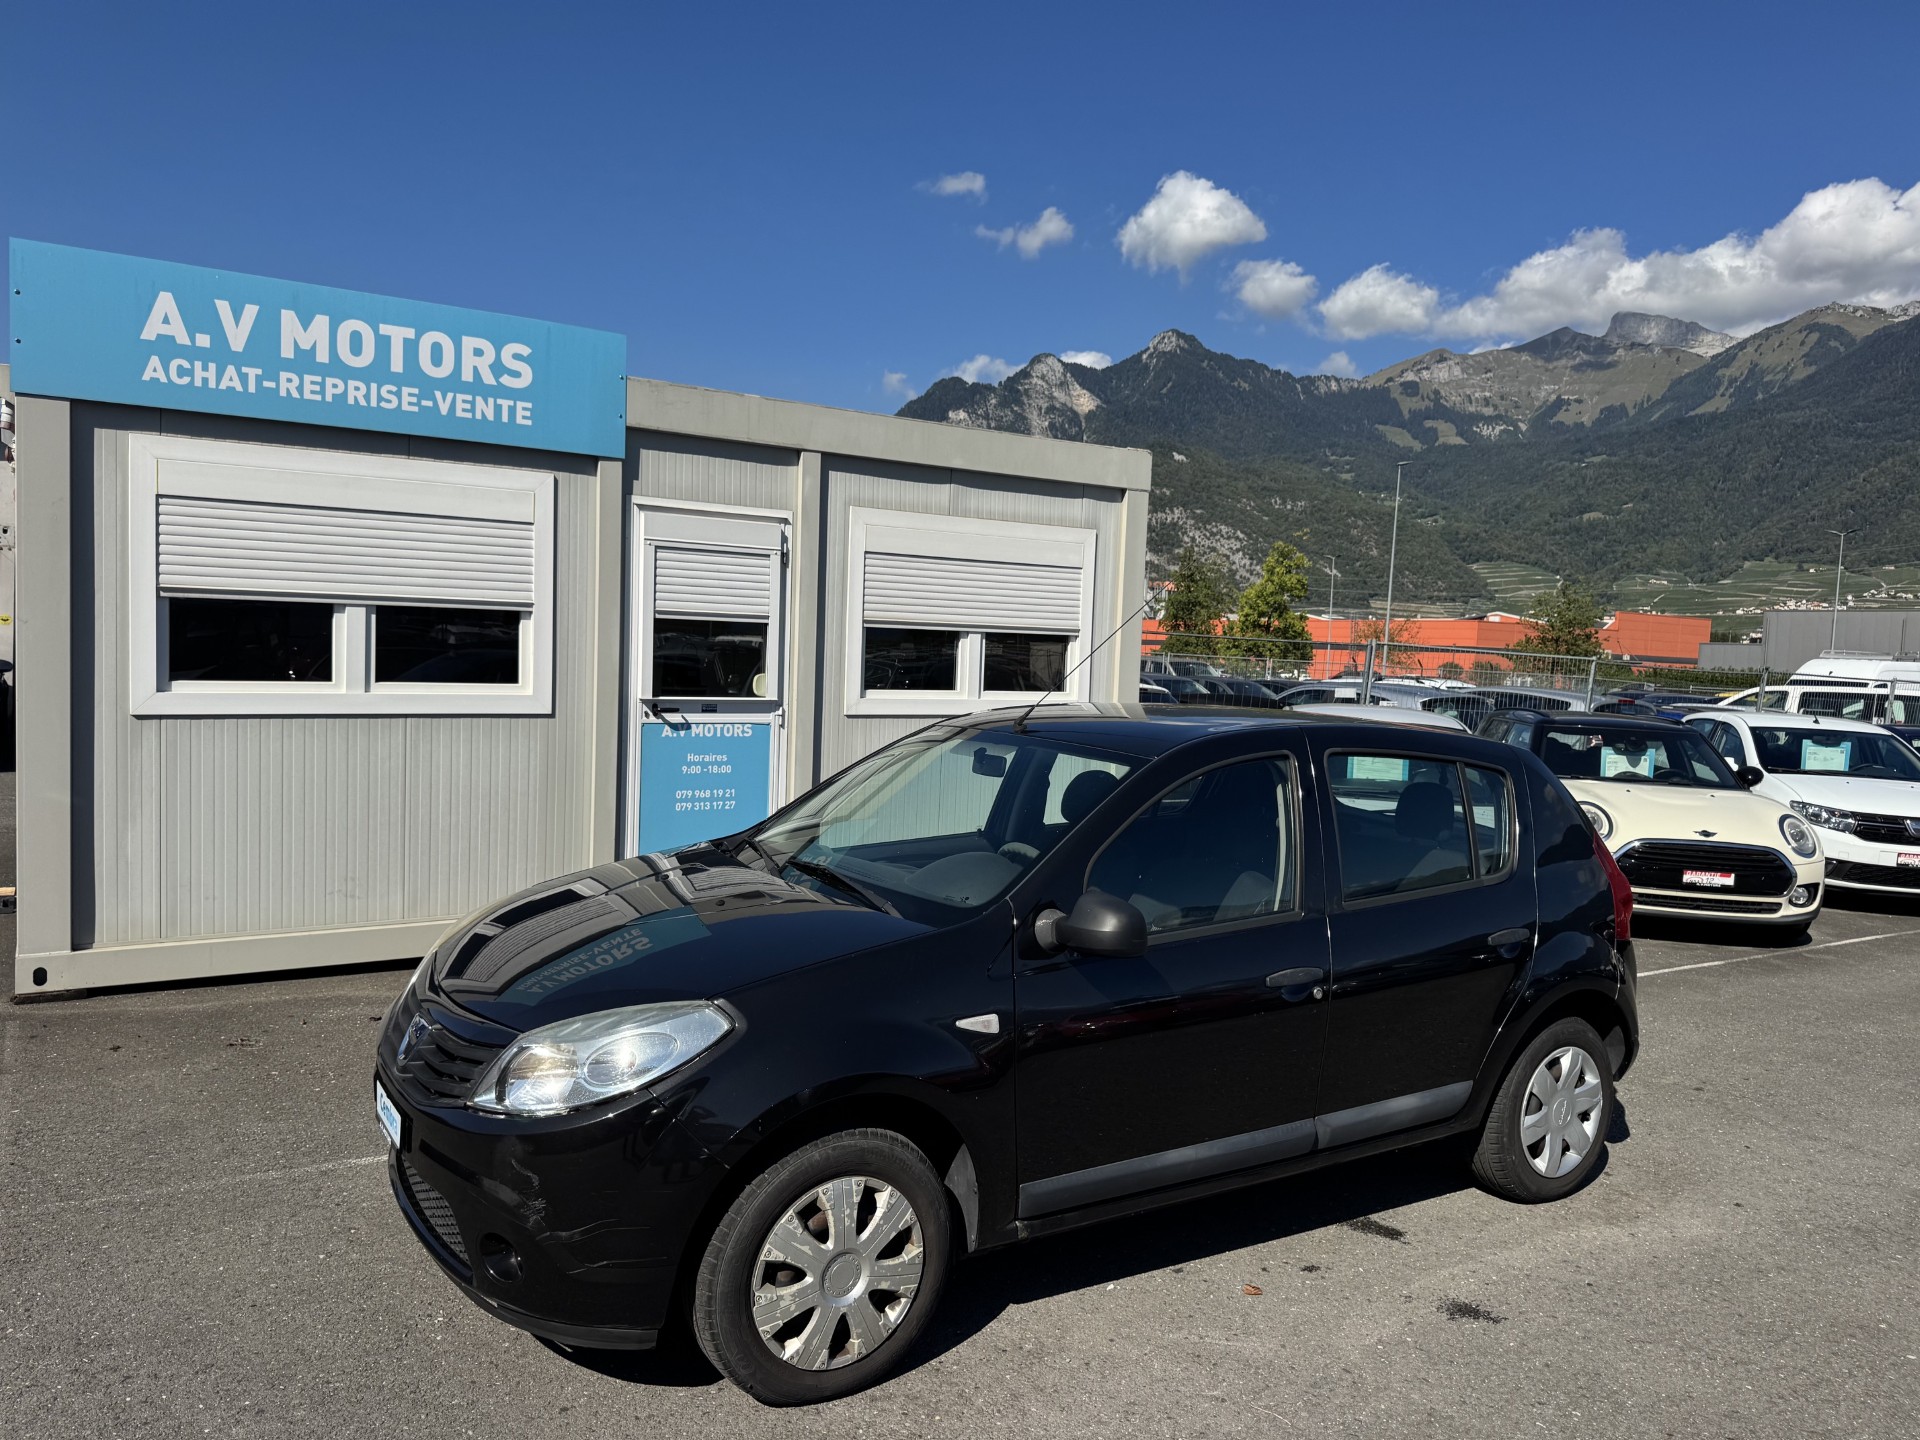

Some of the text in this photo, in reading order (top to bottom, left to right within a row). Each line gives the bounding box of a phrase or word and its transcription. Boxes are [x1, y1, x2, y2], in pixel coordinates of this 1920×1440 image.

[139, 291, 534, 389] A.V MOTORS
[141, 354, 533, 426] ACHAT-REPRISE-VENTE
[661, 724, 753, 737] A.V MOTORS
[687, 753, 728, 762] Horaires
[681, 765, 702, 774] 9:00
[675, 788, 735, 799] 079 968 19 21
[675, 800, 736, 811] 079 313 17 27
